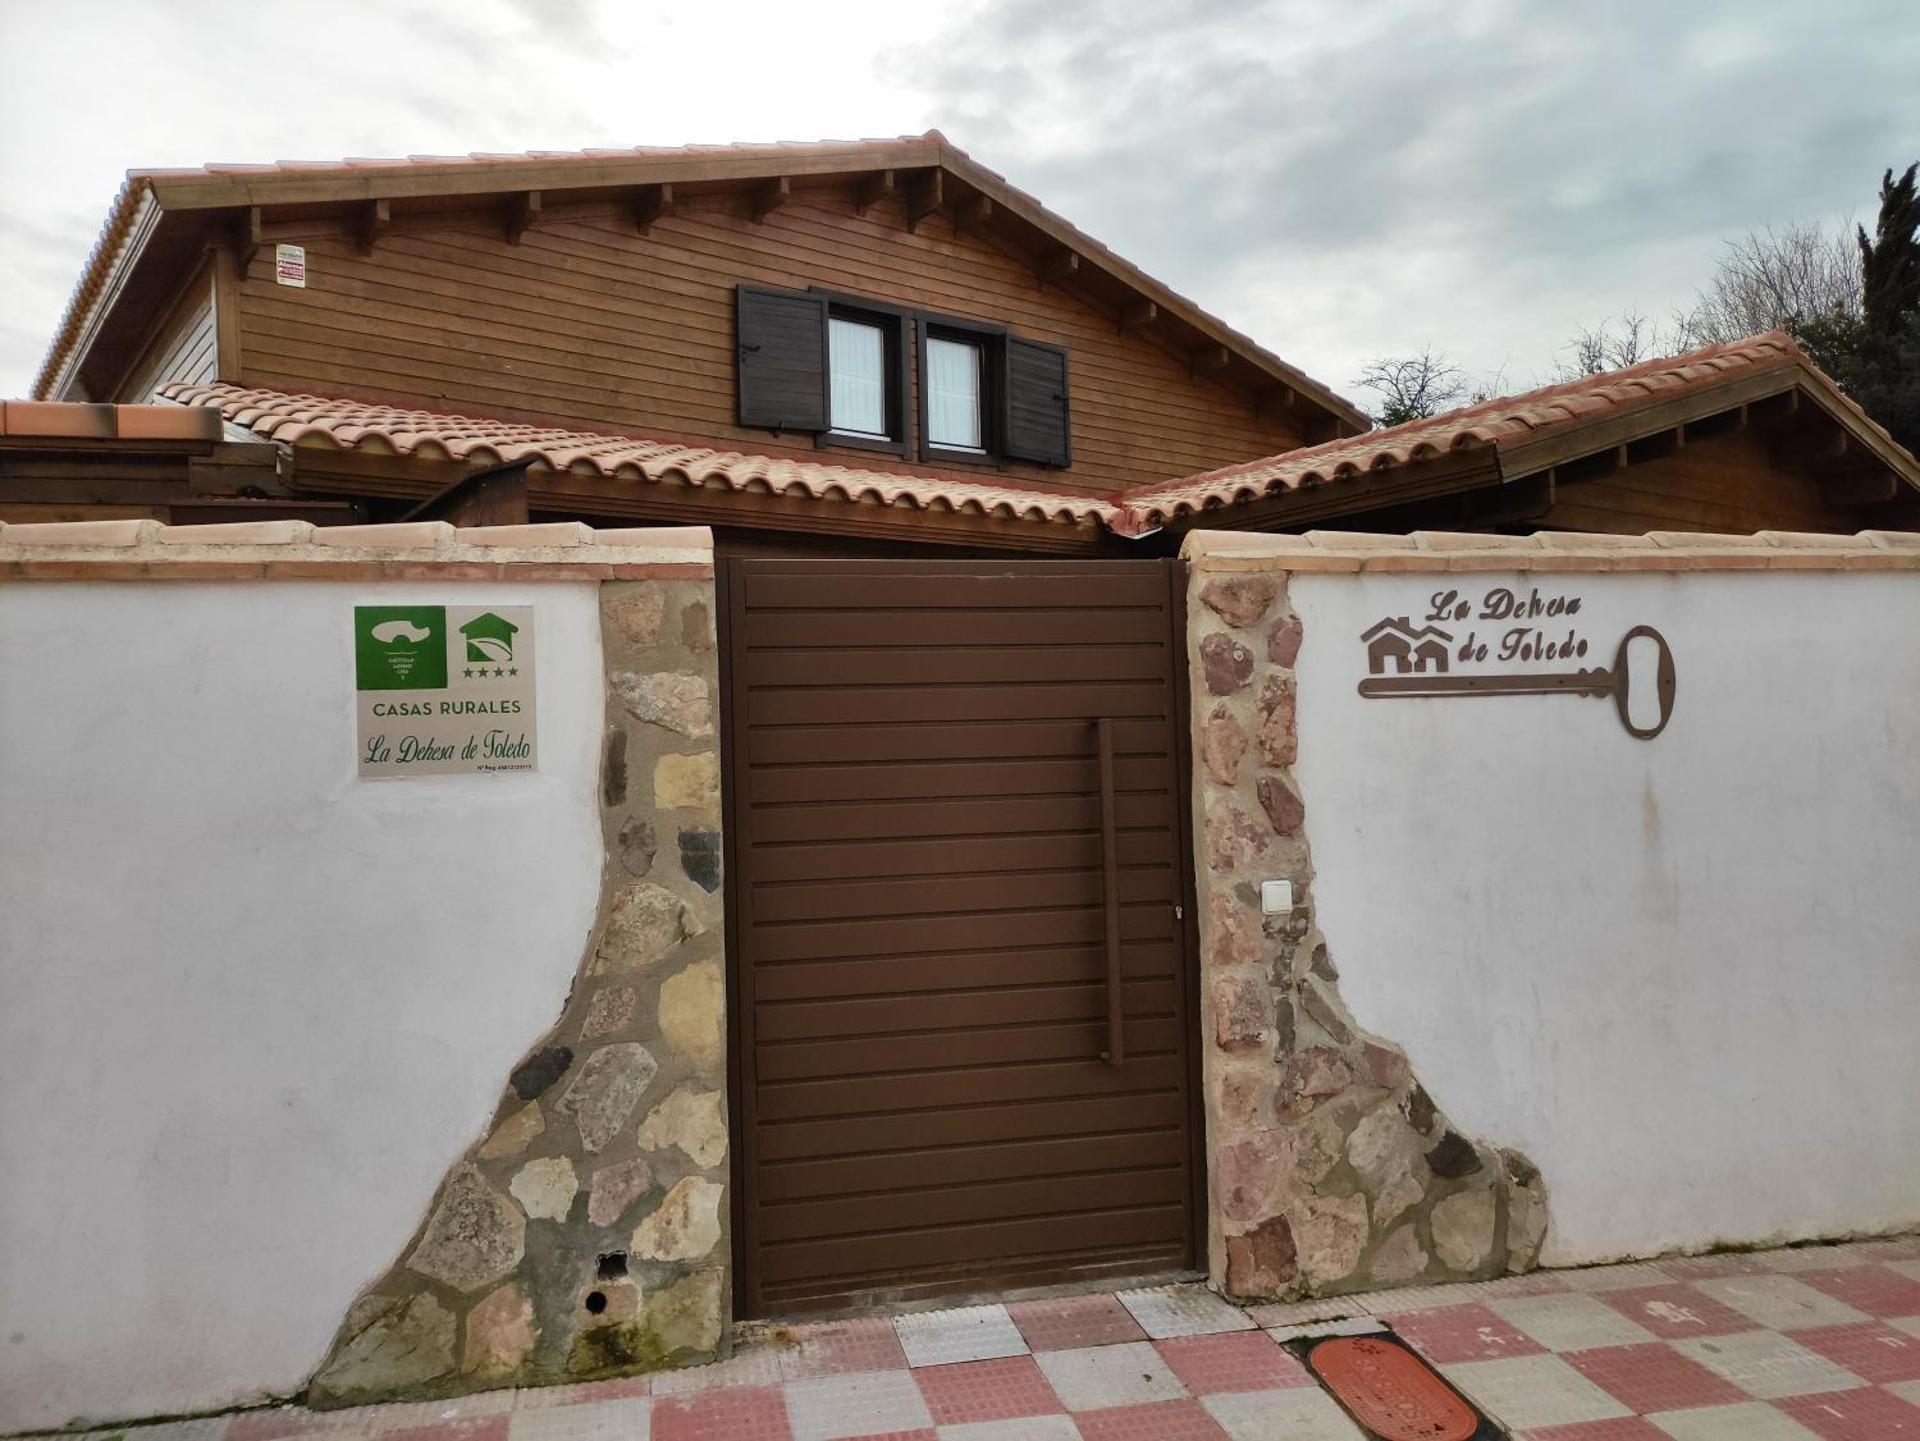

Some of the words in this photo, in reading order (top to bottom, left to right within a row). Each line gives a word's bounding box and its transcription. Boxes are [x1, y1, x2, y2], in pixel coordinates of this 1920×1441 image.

[1425, 589, 1471, 621] La
[1479, 587, 1582, 620] Dehesa
[1458, 632, 1488, 663] de
[1497, 627, 1588, 661] Toledo
[373, 702, 432, 717] CASAS
[440, 700, 521, 715] RURALES
[364, 735, 391, 764] La
[395, 735, 455, 764] Dehesa
[461, 735, 478, 760] de
[483, 729, 531, 759] Toledo
